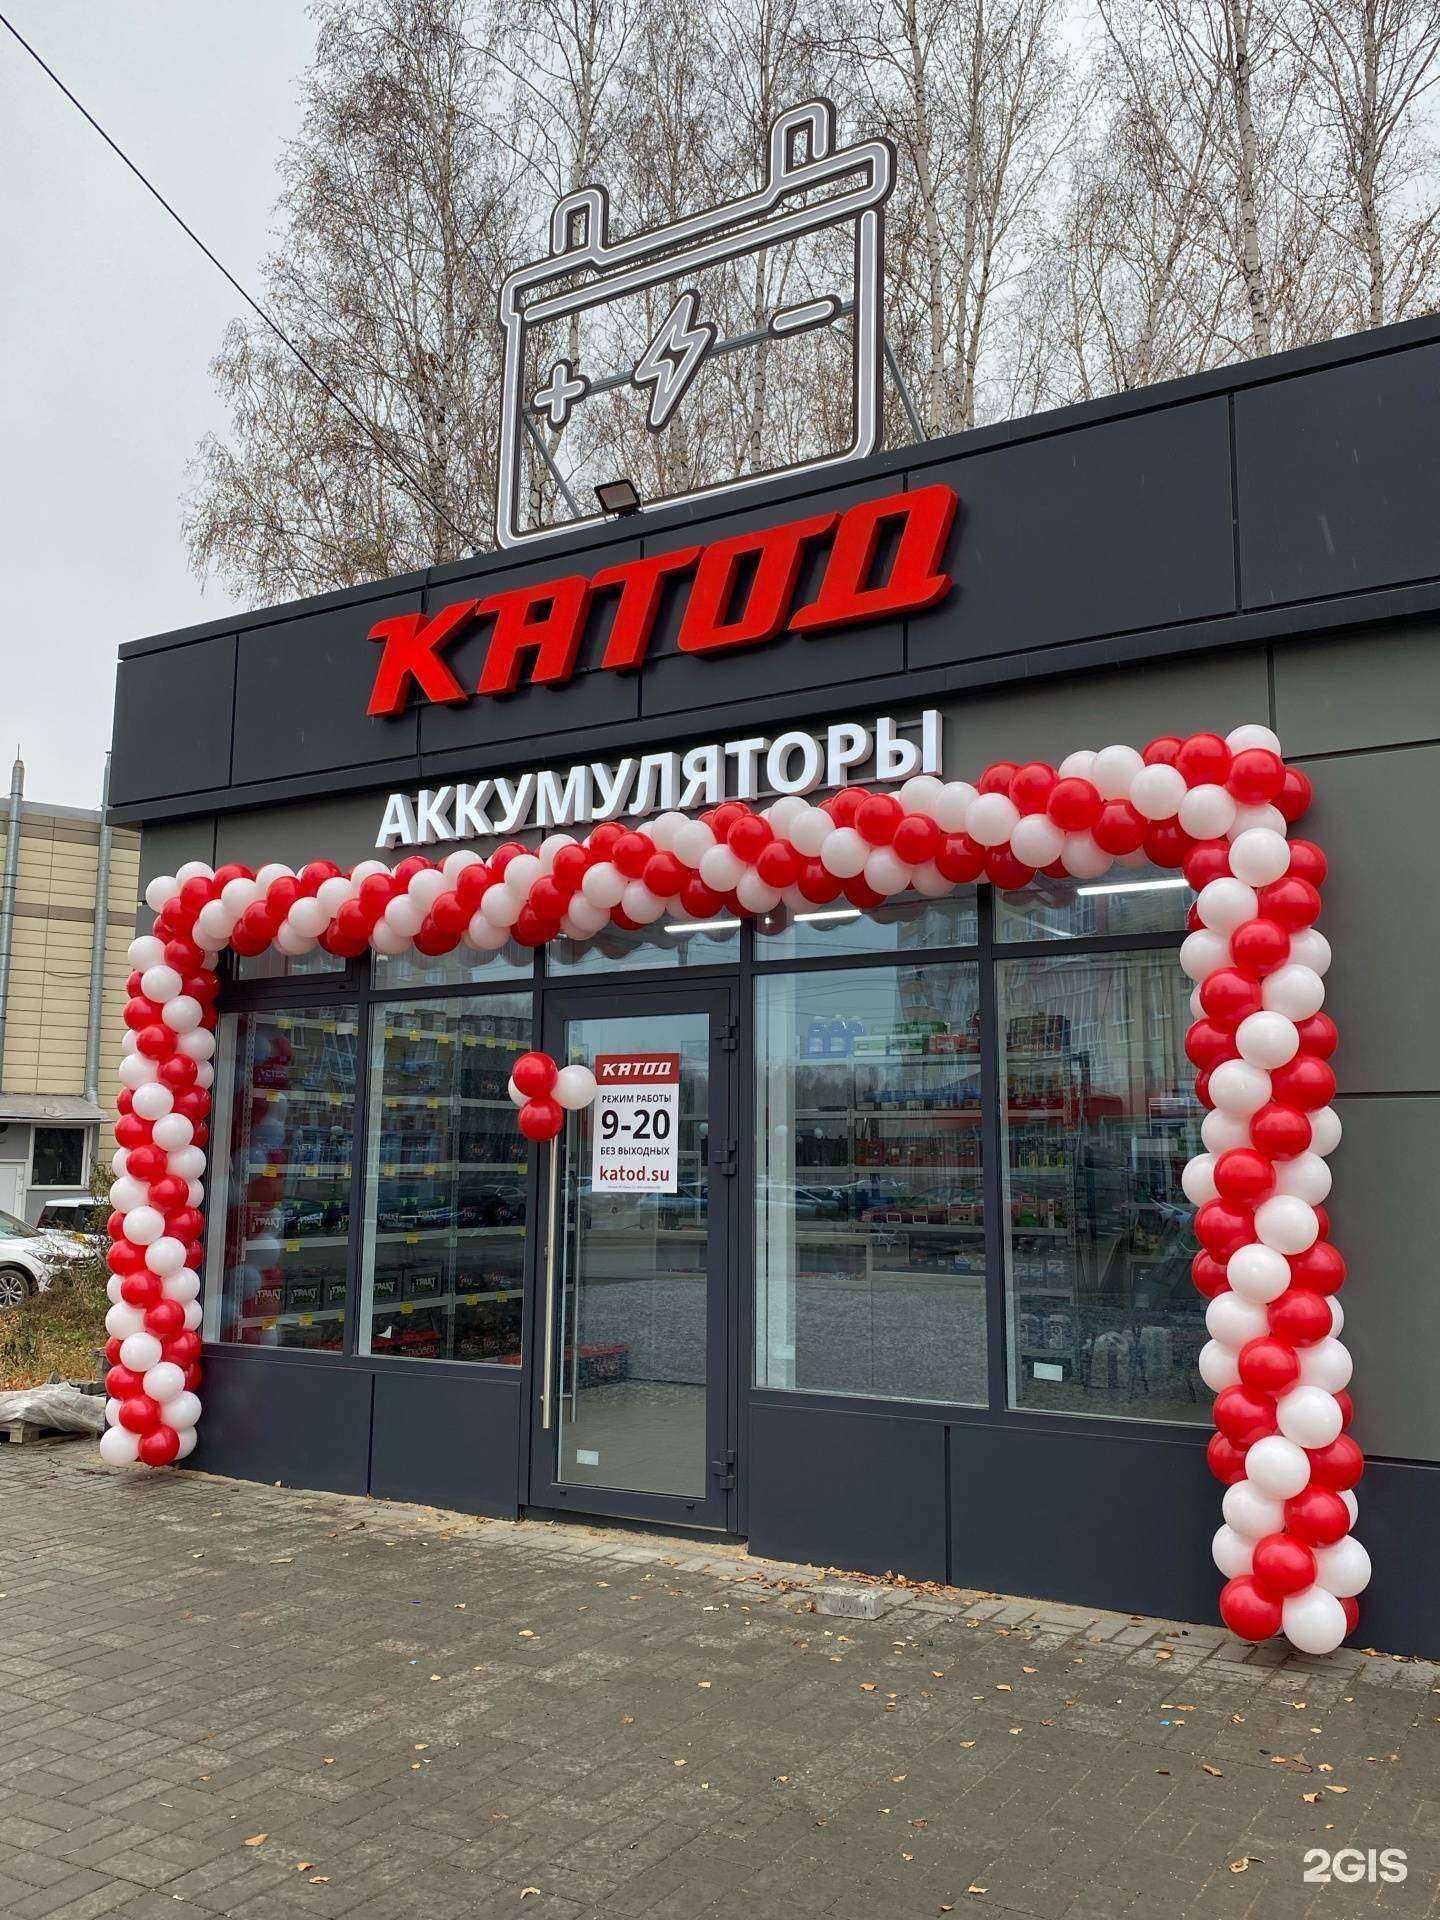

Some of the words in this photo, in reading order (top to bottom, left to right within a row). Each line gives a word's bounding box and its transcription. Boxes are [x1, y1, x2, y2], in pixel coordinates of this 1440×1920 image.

[366, 483, 958, 718] КАТОД
[375, 709, 943, 848] АККУМУЛЯТОРЫ
[602, 1062, 672, 1077] КАТОД
[602, 1095, 634, 1103] РЕЖИМ
[636, 1094, 672, 1103] РАБОТЫ
[601, 1109, 671, 1140] 9-20
[600, 1146, 616, 1155] БЕЗ
[618, 1146, 670, 1157] ВЫХОДНЫХ
[600, 1165, 670, 1182] katod.su
